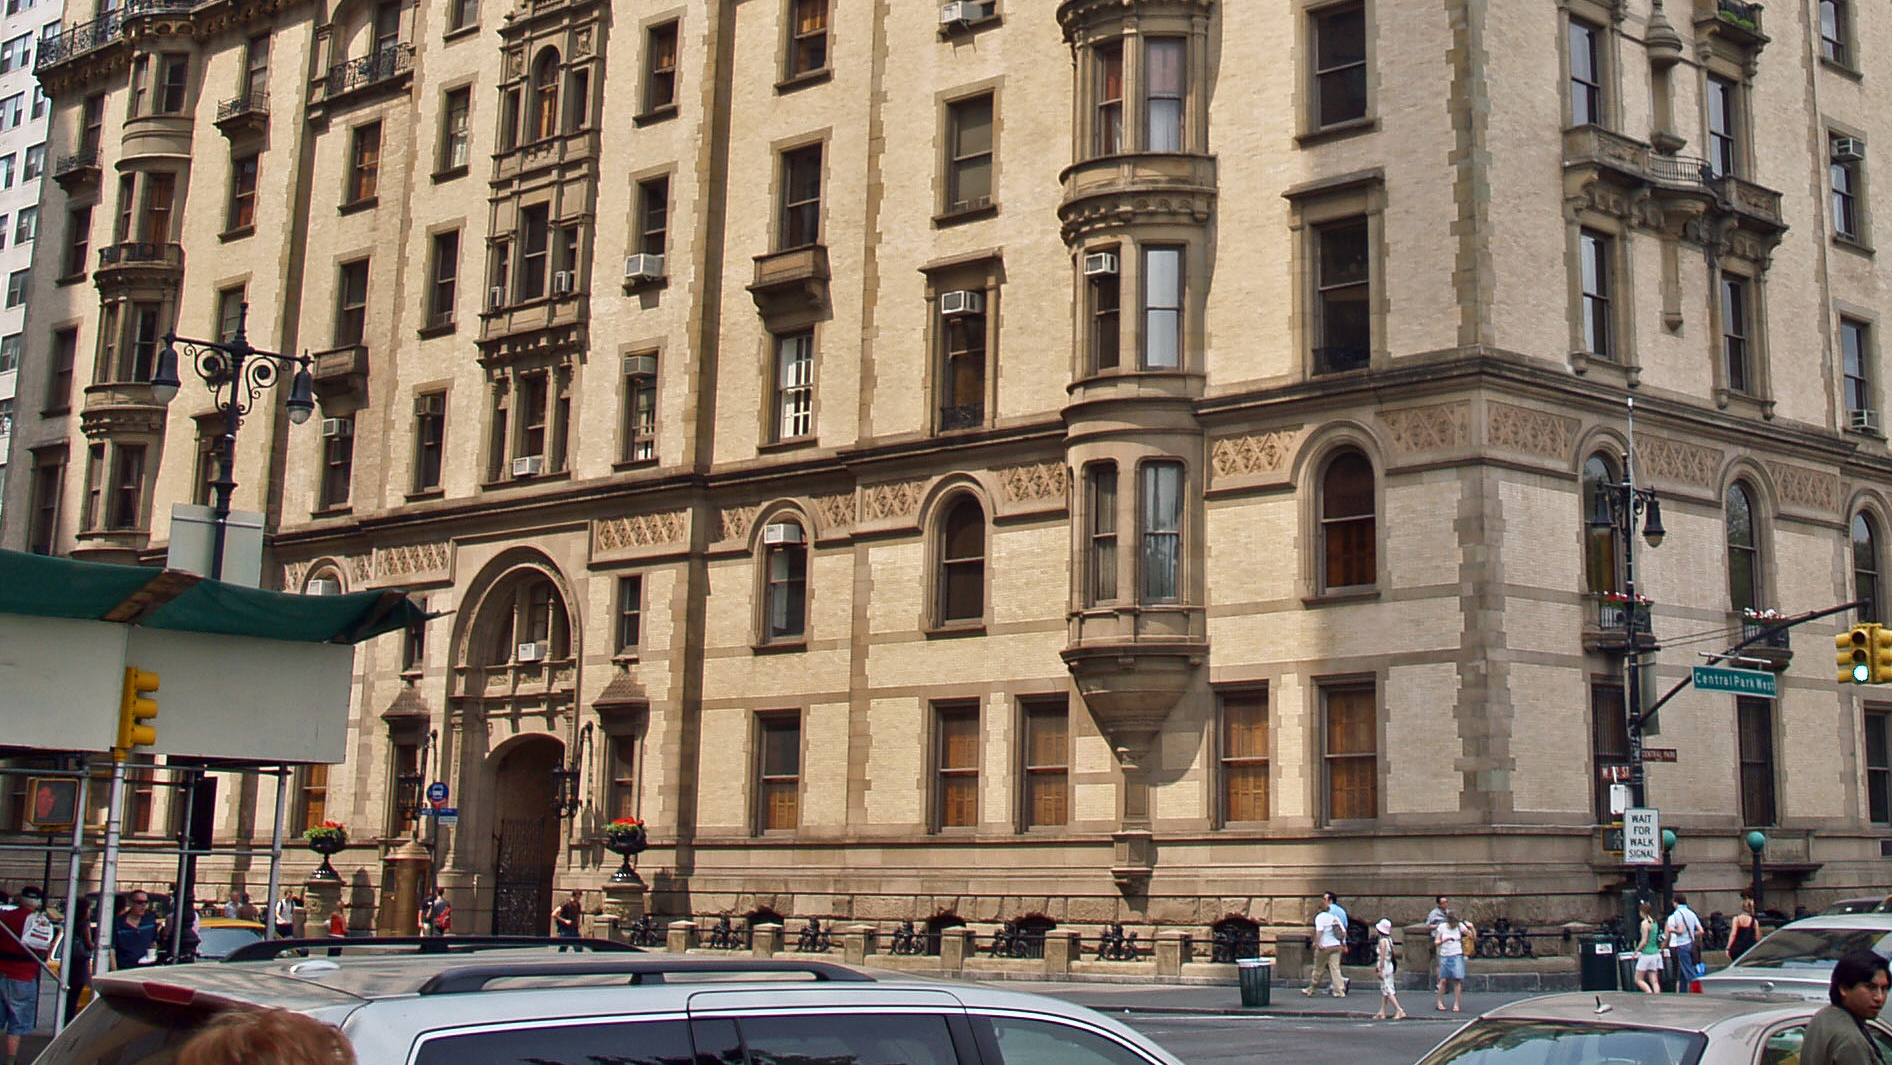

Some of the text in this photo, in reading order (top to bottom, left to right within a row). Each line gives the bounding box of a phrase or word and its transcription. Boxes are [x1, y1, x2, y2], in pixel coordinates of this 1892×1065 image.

[1695, 672, 1733, 686] Central
[1734, 675, 1755, 689] Park
[1631, 814, 1652, 823] WAIT
[1633, 826, 1651, 835] FOR
[1629, 837, 1655, 847] WALK
[1628, 849, 1656, 859] SIGNAL
